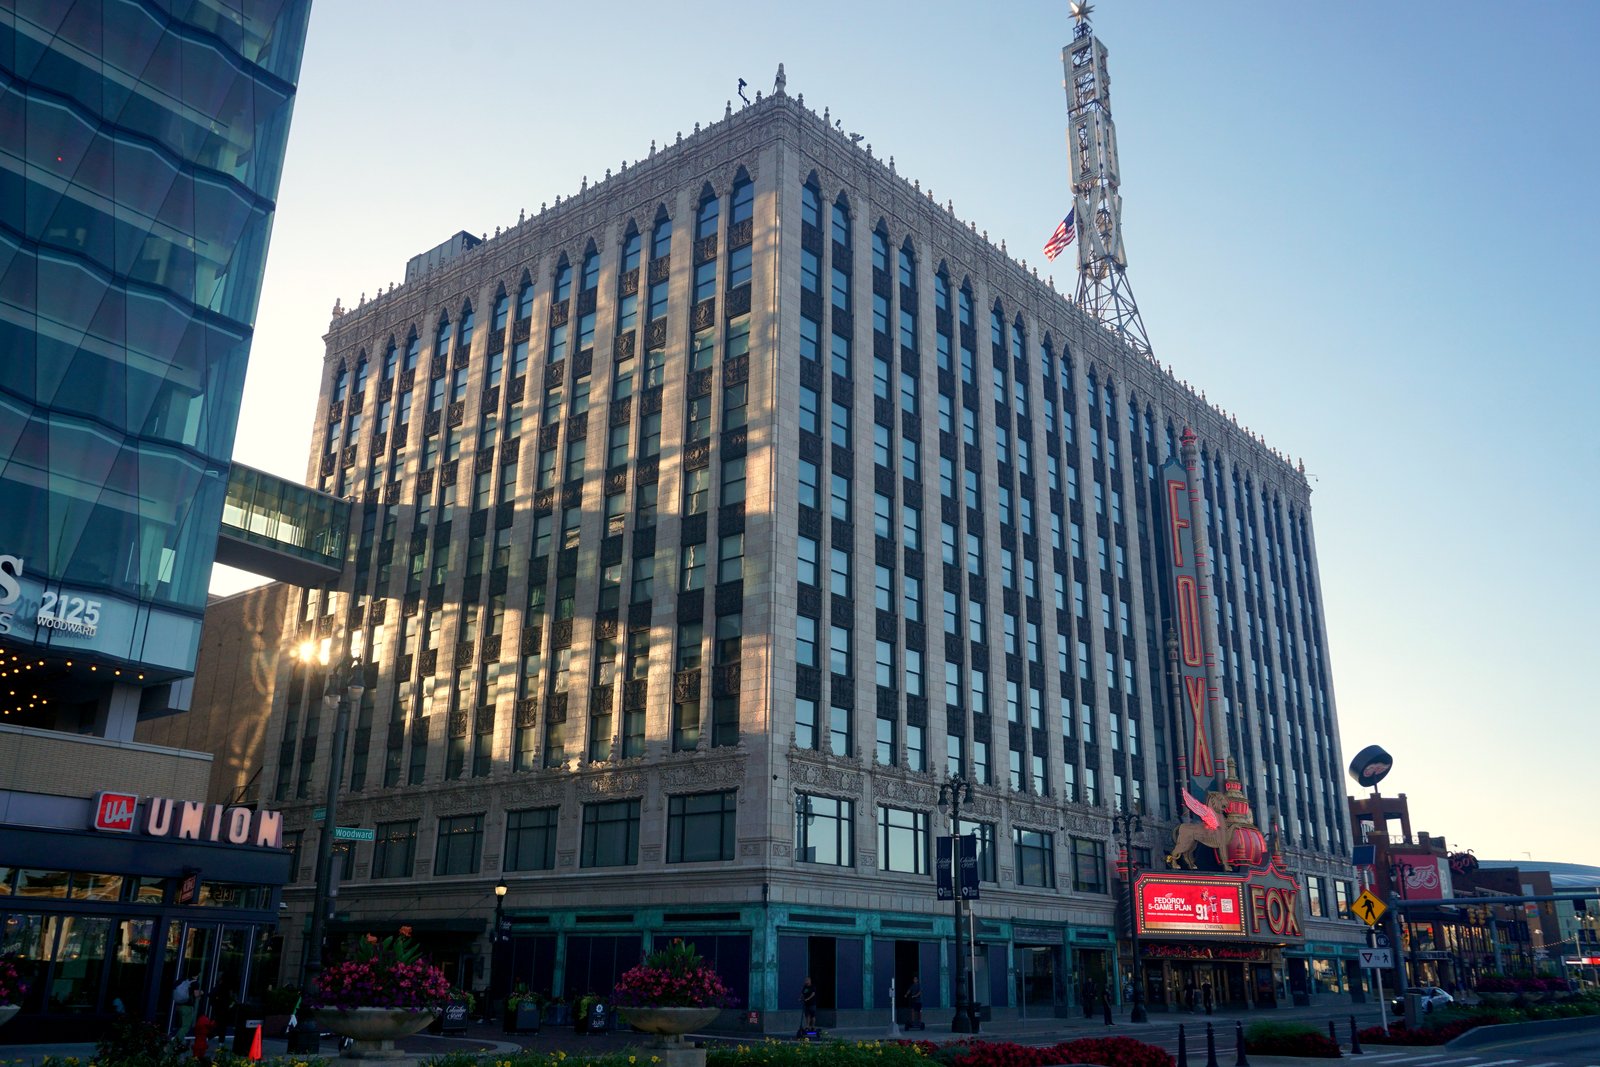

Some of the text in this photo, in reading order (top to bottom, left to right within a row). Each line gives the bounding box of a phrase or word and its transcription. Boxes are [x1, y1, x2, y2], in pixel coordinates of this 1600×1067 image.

[38, 591, 101, 626] 2125
[37, 615, 97, 636] WOODWARD
[1167, 479, 1213, 777] FOX
[104, 799, 132, 823] UA
[147, 797, 281, 847] UNION
[335, 829, 373, 839] Woodward
[1148, 903, 1192, 912] 5-GAME PLAN
[1154, 897, 1185, 905] FEDOROV
[1248, 883, 1303, 936] FOX
[1195, 904, 1209, 921] 91
